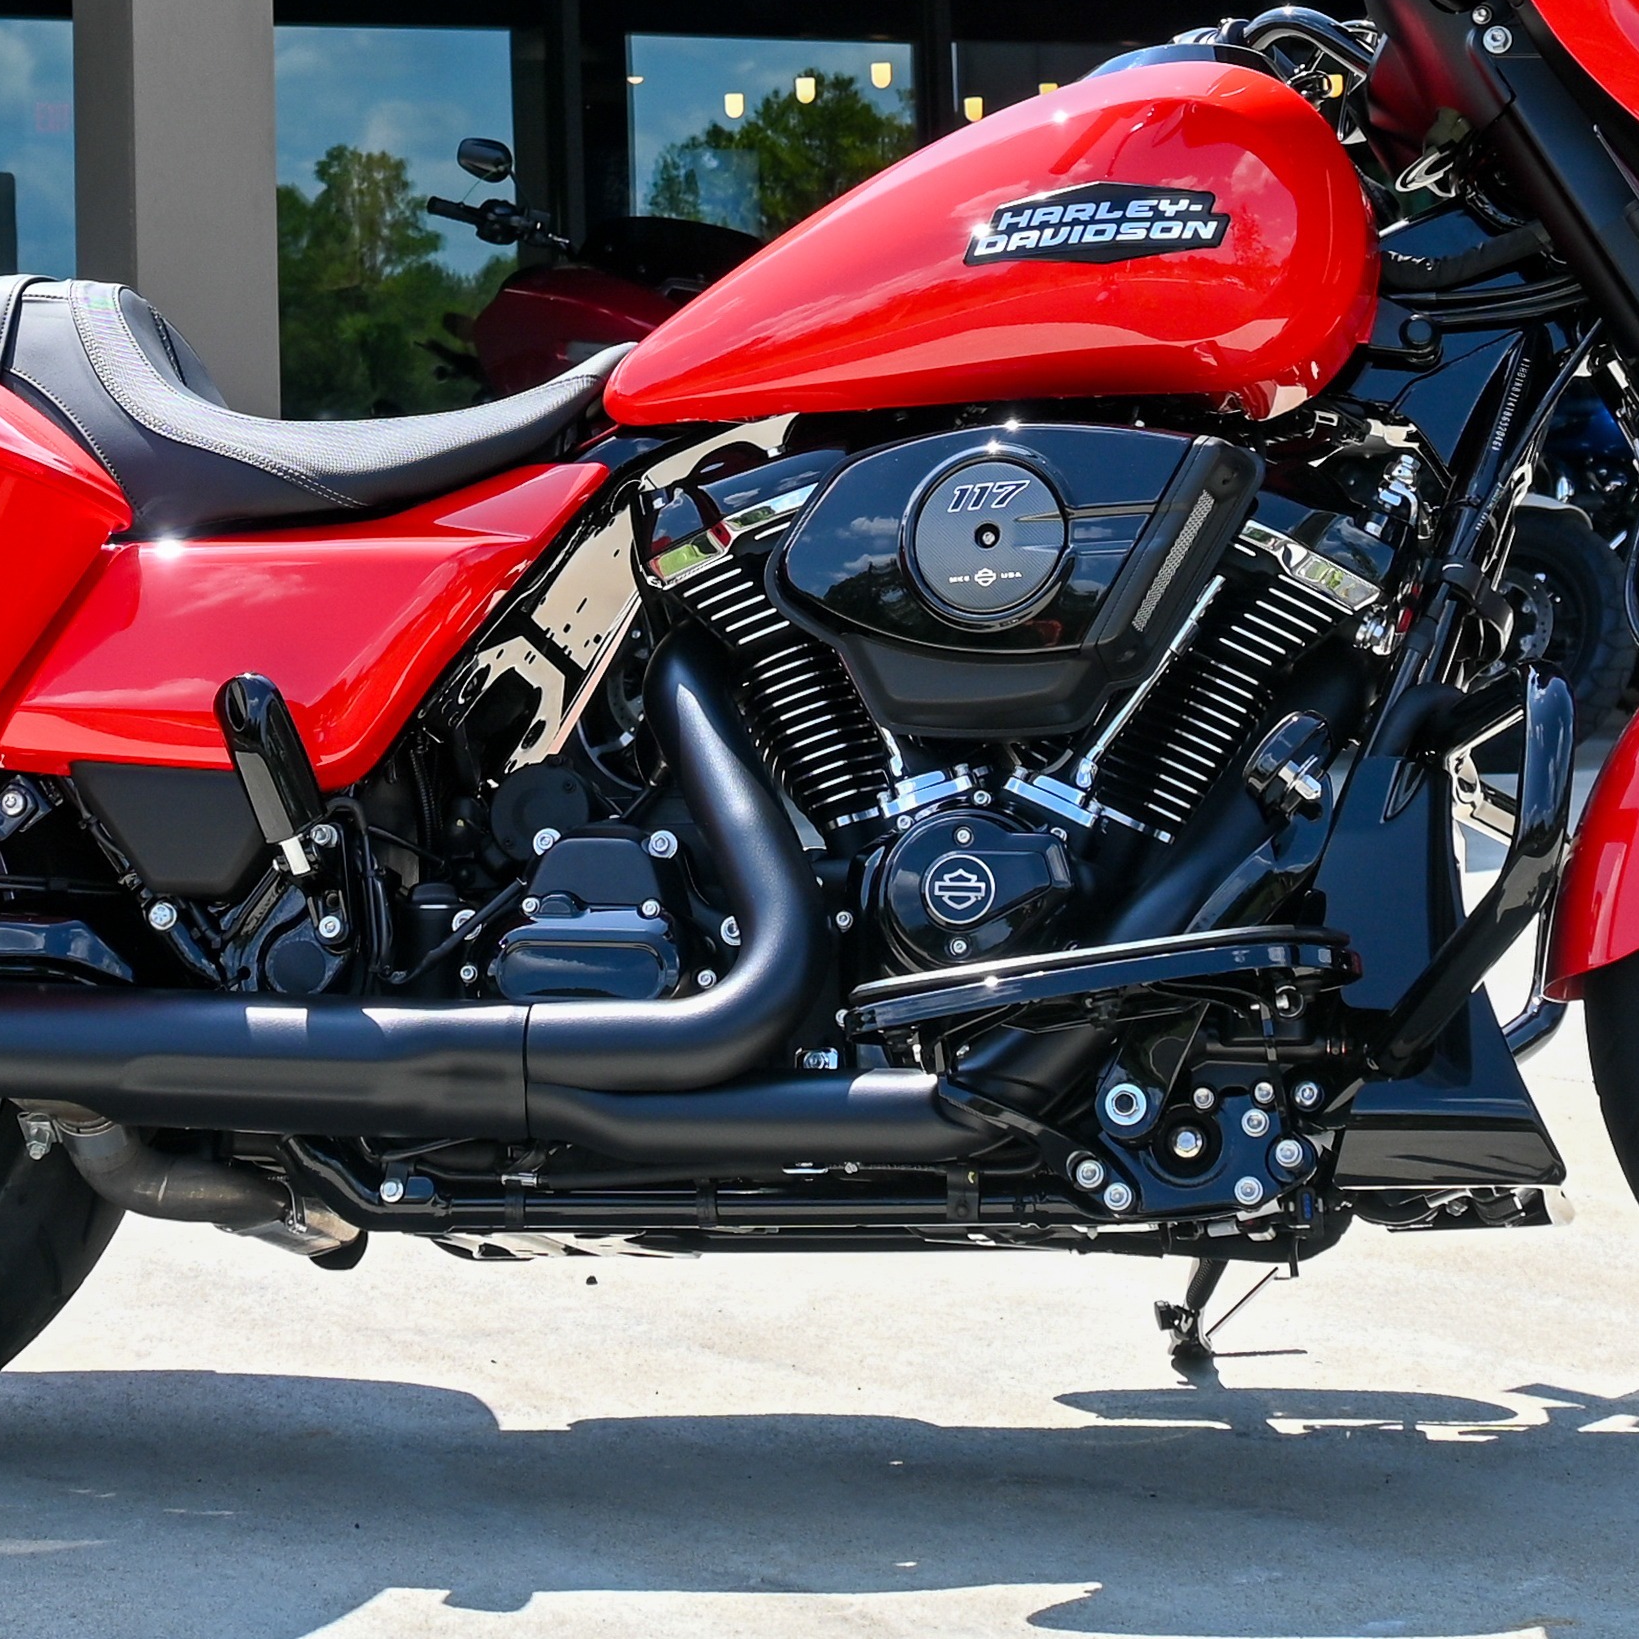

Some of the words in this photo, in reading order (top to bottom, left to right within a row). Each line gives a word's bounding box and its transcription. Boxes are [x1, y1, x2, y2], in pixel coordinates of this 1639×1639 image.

[997, 199, 1204, 231] HARLEY-
[973, 220, 1219, 257] DAVIDSON
[947, 479, 1031, 513] 117
